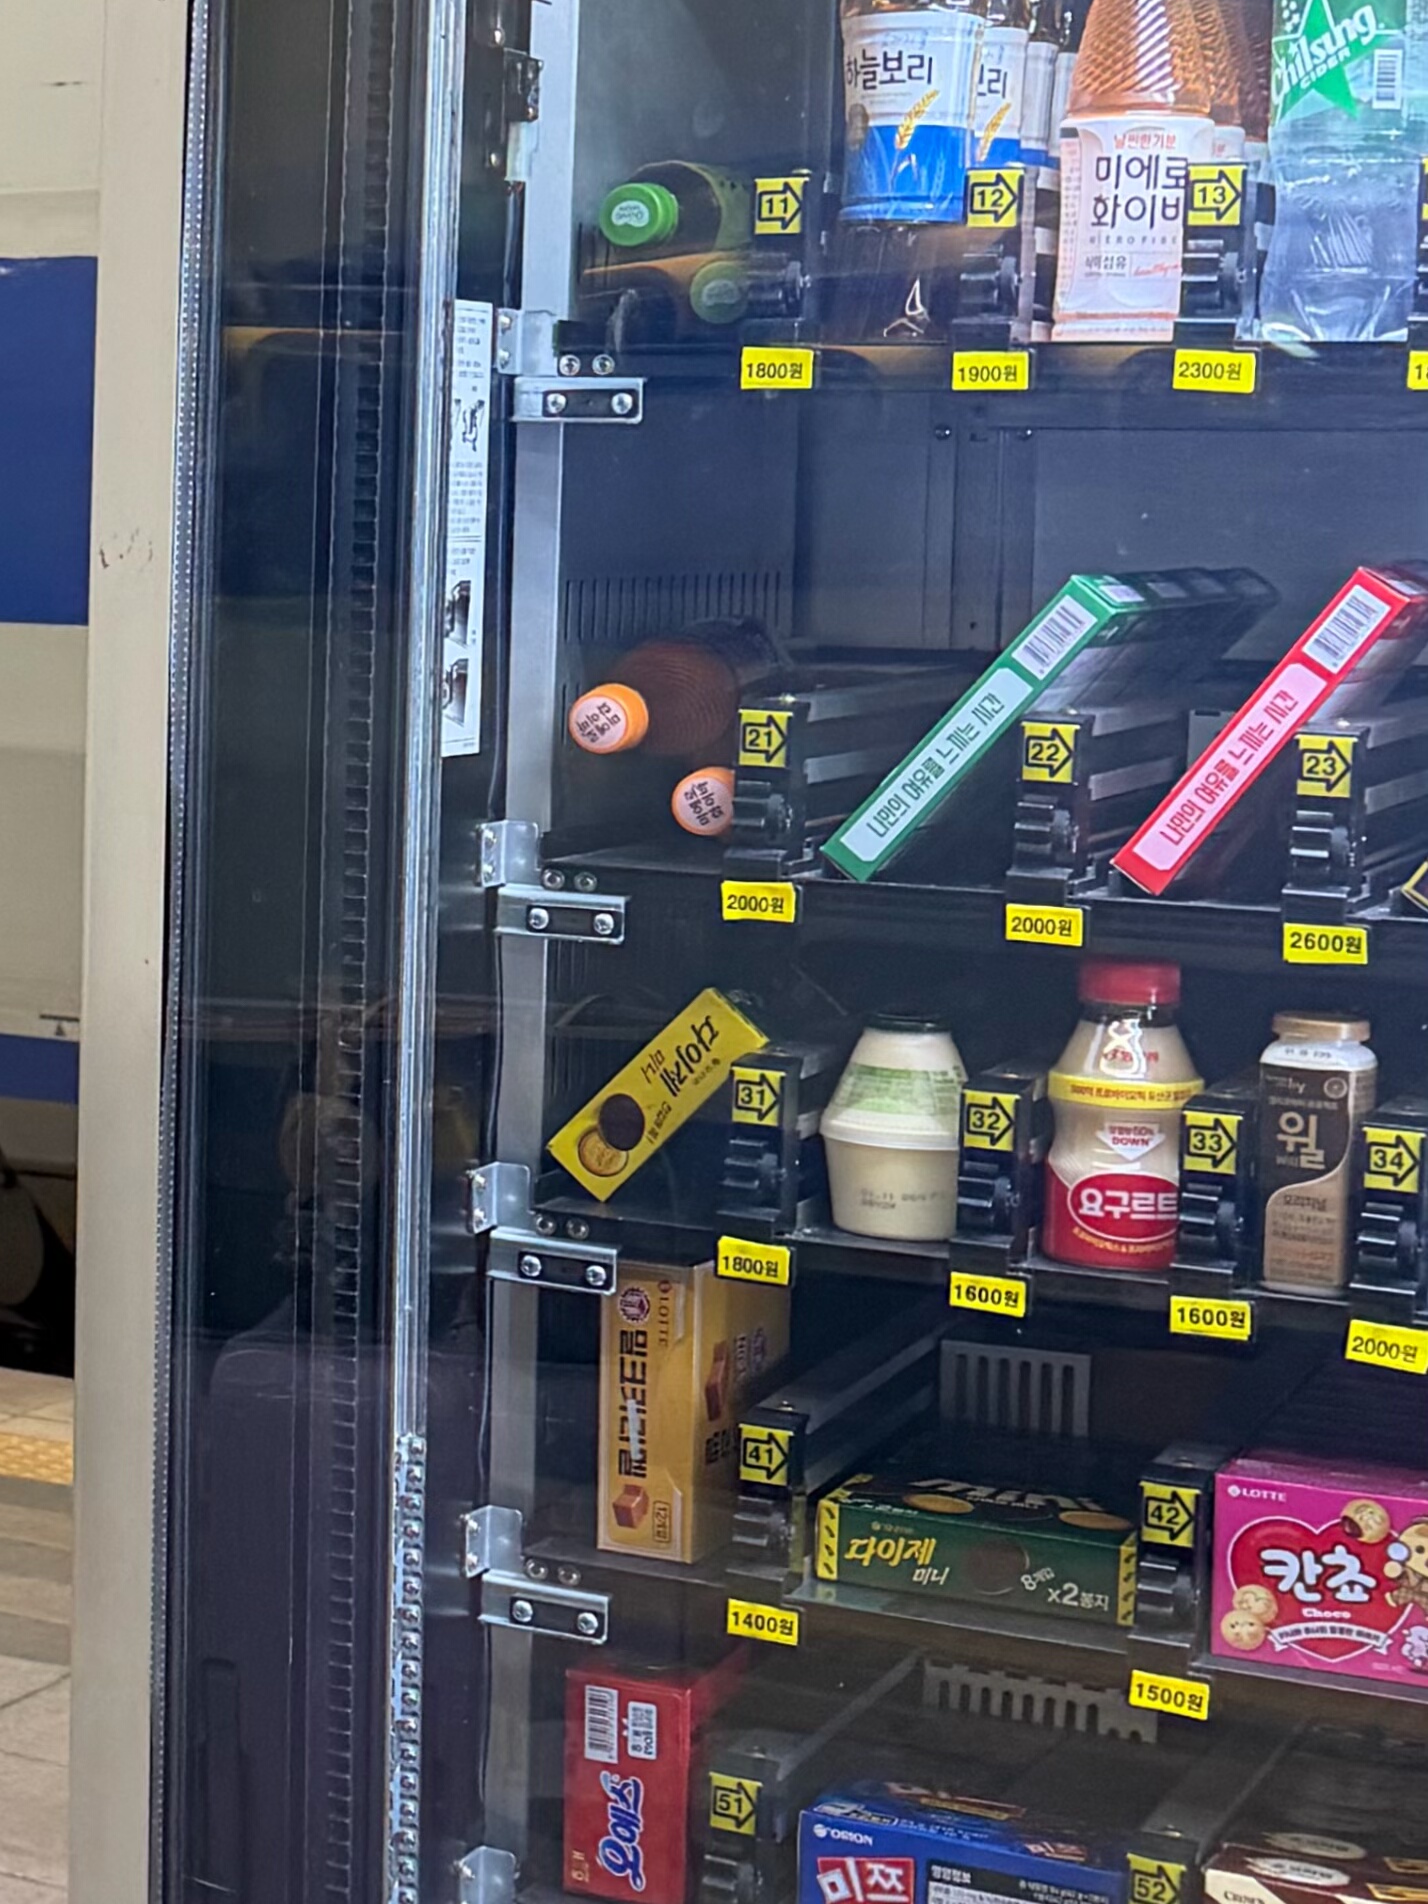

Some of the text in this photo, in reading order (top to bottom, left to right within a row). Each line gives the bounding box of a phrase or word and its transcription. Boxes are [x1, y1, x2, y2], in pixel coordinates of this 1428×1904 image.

[845, 49, 933, 90] 하늘보리
[1300, 46, 1352, 91] CIDER
[1095, 153, 1190, 191] 미에로
[978, 188, 1003, 209] 12
[1197, 185, 1227, 204] 13
[766, 199, 789, 216] 11
[745, 362, 804, 382] 1800원
[958, 364, 1019, 384] 1900원
[1178, 361, 1242, 381] 2300원
[747, 728, 773, 748] 21
[1030, 743, 1060, 763] 22
[866, 691, 1006, 839] 나만의 여유를 느끼는 시간
[1160, 689, 1300, 847] 나만의 여유를 느끼는 시간
[1306, 755, 1337, 776] 23
[726, 894, 785, 914] 2000원
[1011, 916, 1073, 937] 2000원
[1290, 934, 1362, 955] 2600원
[640, 1047, 665, 1085] 미니
[662, 1015, 720, 1098] 다이제
[740, 1084, 766, 1106] 31
[972, 1110, 1001, 1131] 32
[1192, 1133, 1222, 1152] 33
[1373, 1149, 1404, 1170] 34
[1078, 1188, 1178, 1220] 요구르트
[722, 1255, 779, 1278] 1800원
[954, 1283, 1020, 1308] 1600원
[657, 1295, 670, 1348] LOTTE
[1176, 1307, 1246, 1328] 1600원
[1352, 1336, 1418, 1363] 2000원
[748, 1446, 774, 1466] 41
[1242, 1488, 1287, 1502] LOTTE
[1150, 1506, 1181, 1525] 42
[844, 1536, 937, 1567] 다이제
[912, 1567, 950, 1586] 미니
[1259, 1544, 1378, 1603] 칸쵸
[731, 1611, 794, 1636] 1400원
[1135, 1681, 1204, 1713] 1500원
[716, 1794, 744, 1813] 51
[596, 1770, 647, 1893] 오예스
[830, 1828, 873, 1846] ORION
[816, 1856, 910, 1904] 미쯔
[1135, 1878, 1165, 1899] 52
